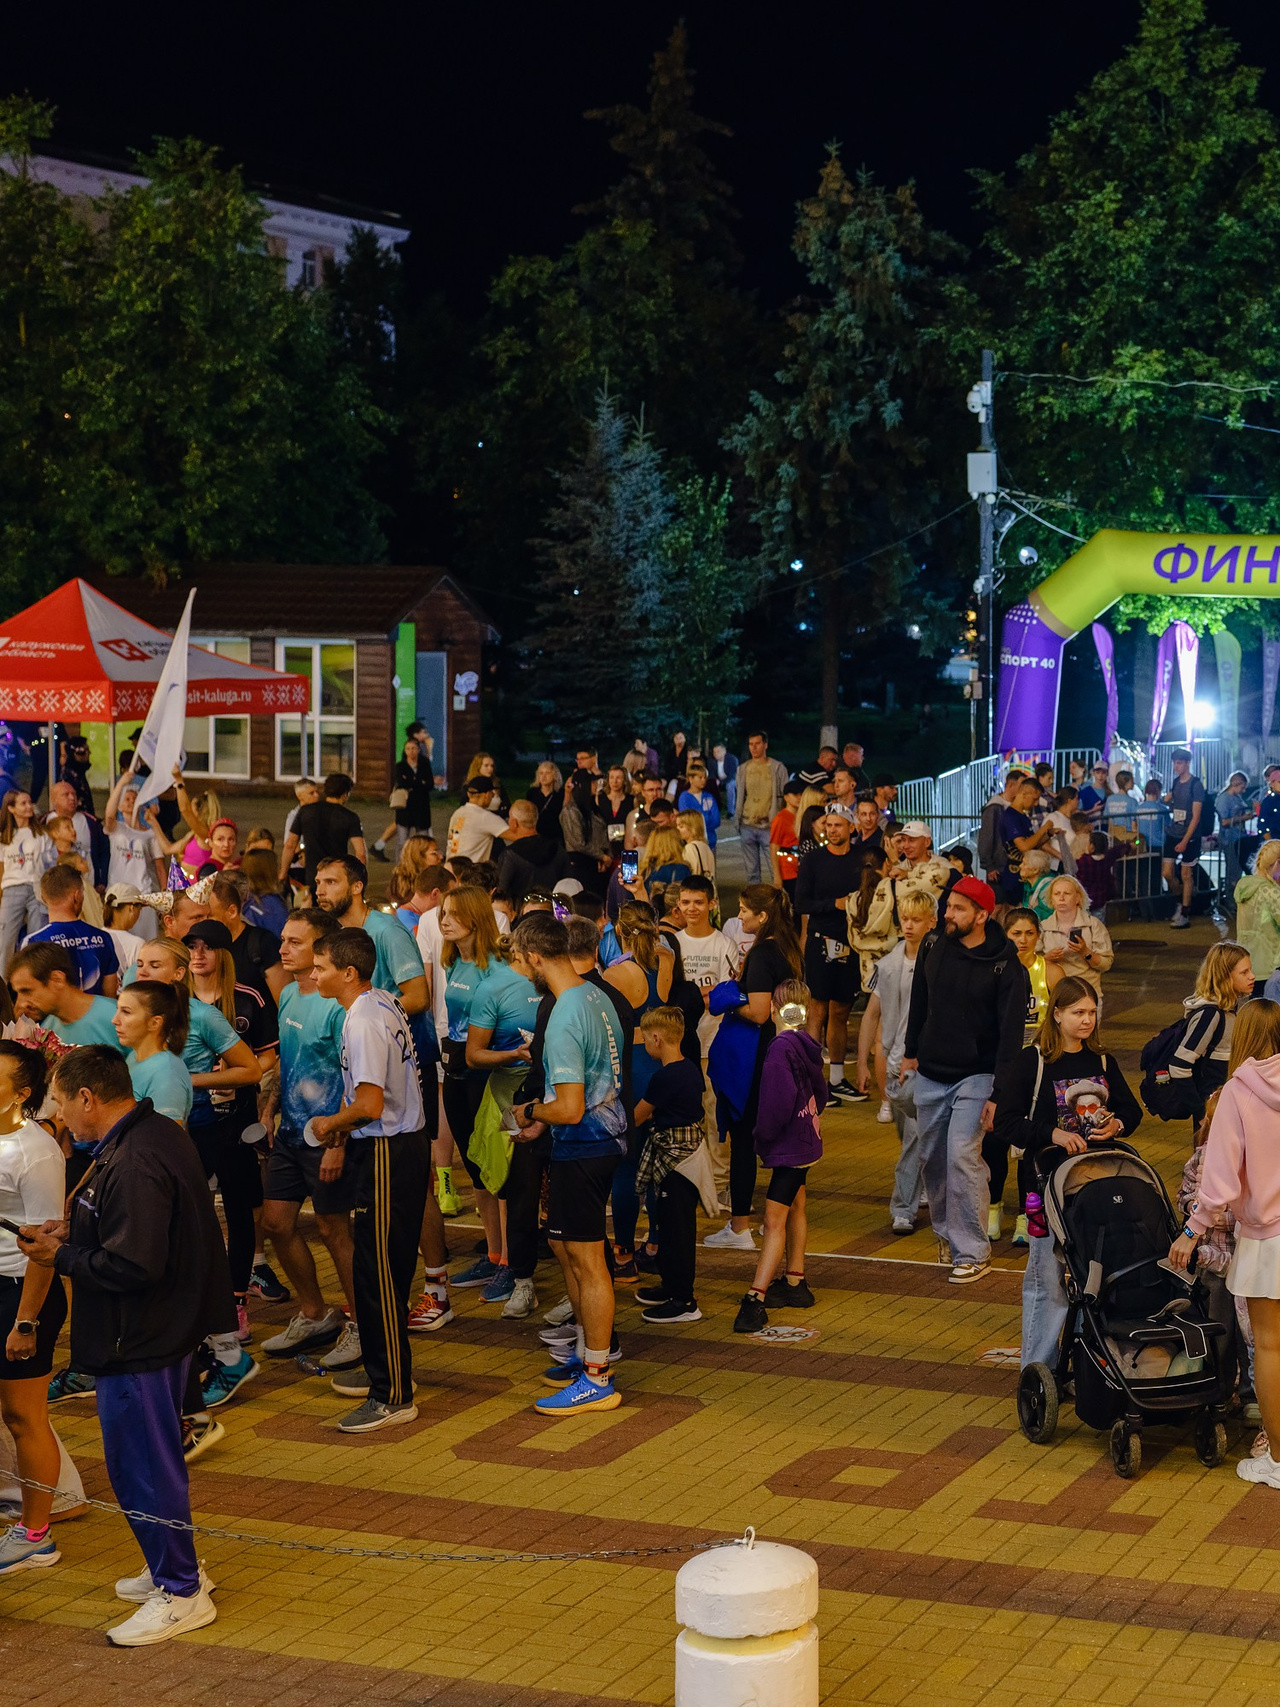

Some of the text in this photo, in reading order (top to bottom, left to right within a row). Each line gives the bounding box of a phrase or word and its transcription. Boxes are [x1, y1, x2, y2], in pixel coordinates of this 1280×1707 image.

[1040, 658, 1055, 669] 40
[187, 690, 252, 705] sit-kaluga.ru
[91, 936, 104, 945] 40
[450, 981, 471, 990] Pandora
[571, 1388, 598, 1402] HOKA
